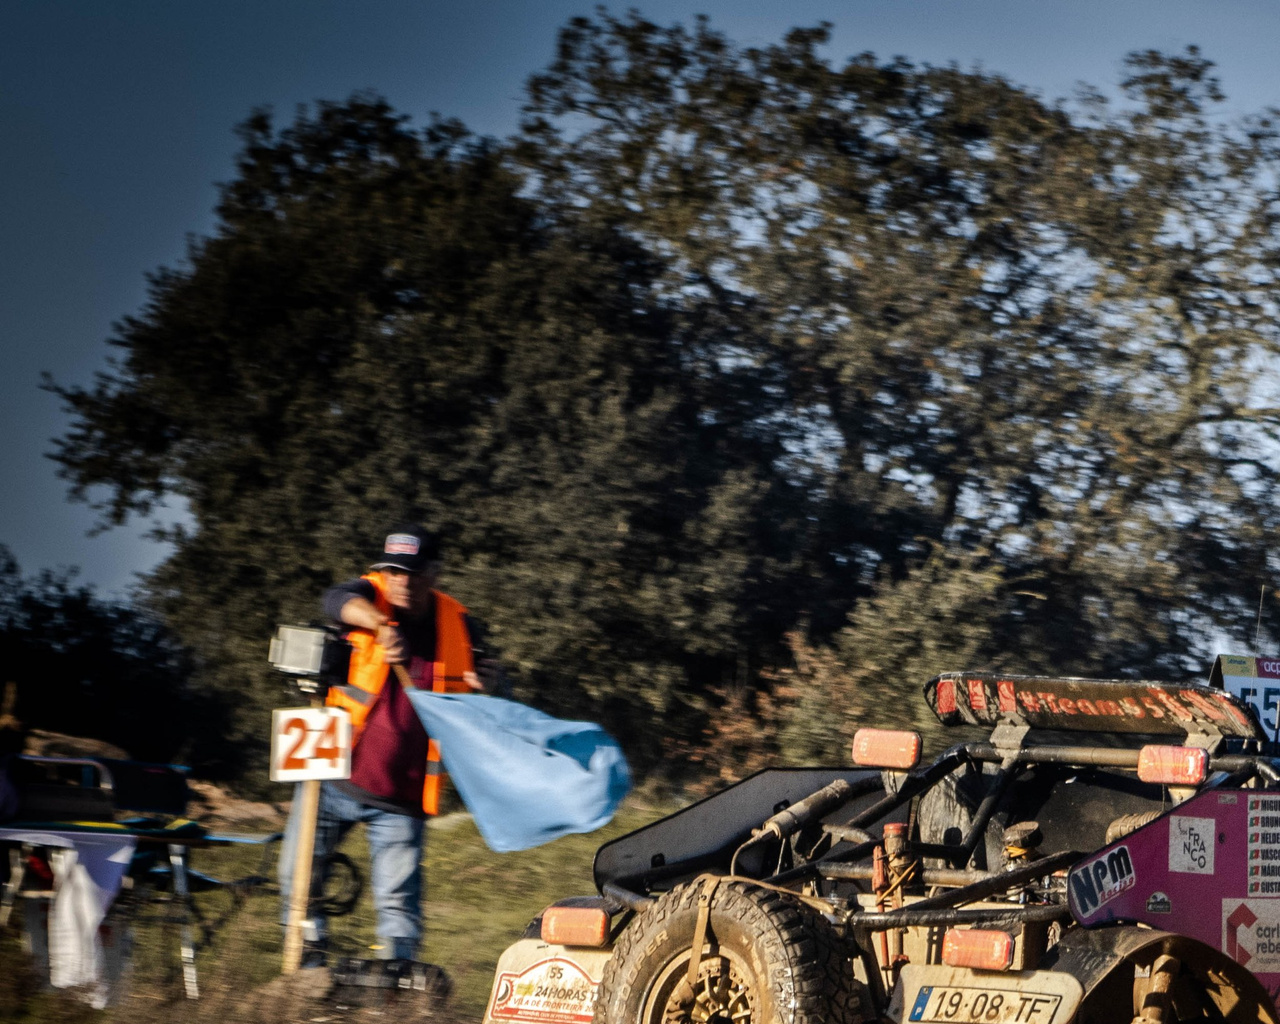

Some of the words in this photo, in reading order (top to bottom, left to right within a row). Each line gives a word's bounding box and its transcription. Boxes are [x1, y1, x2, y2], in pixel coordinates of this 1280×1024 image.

[281, 715, 342, 770] 24
[1070, 846, 1133, 915] NPM
[550, 967, 565, 980] 55
[914, 1007, 922, 1016] P
